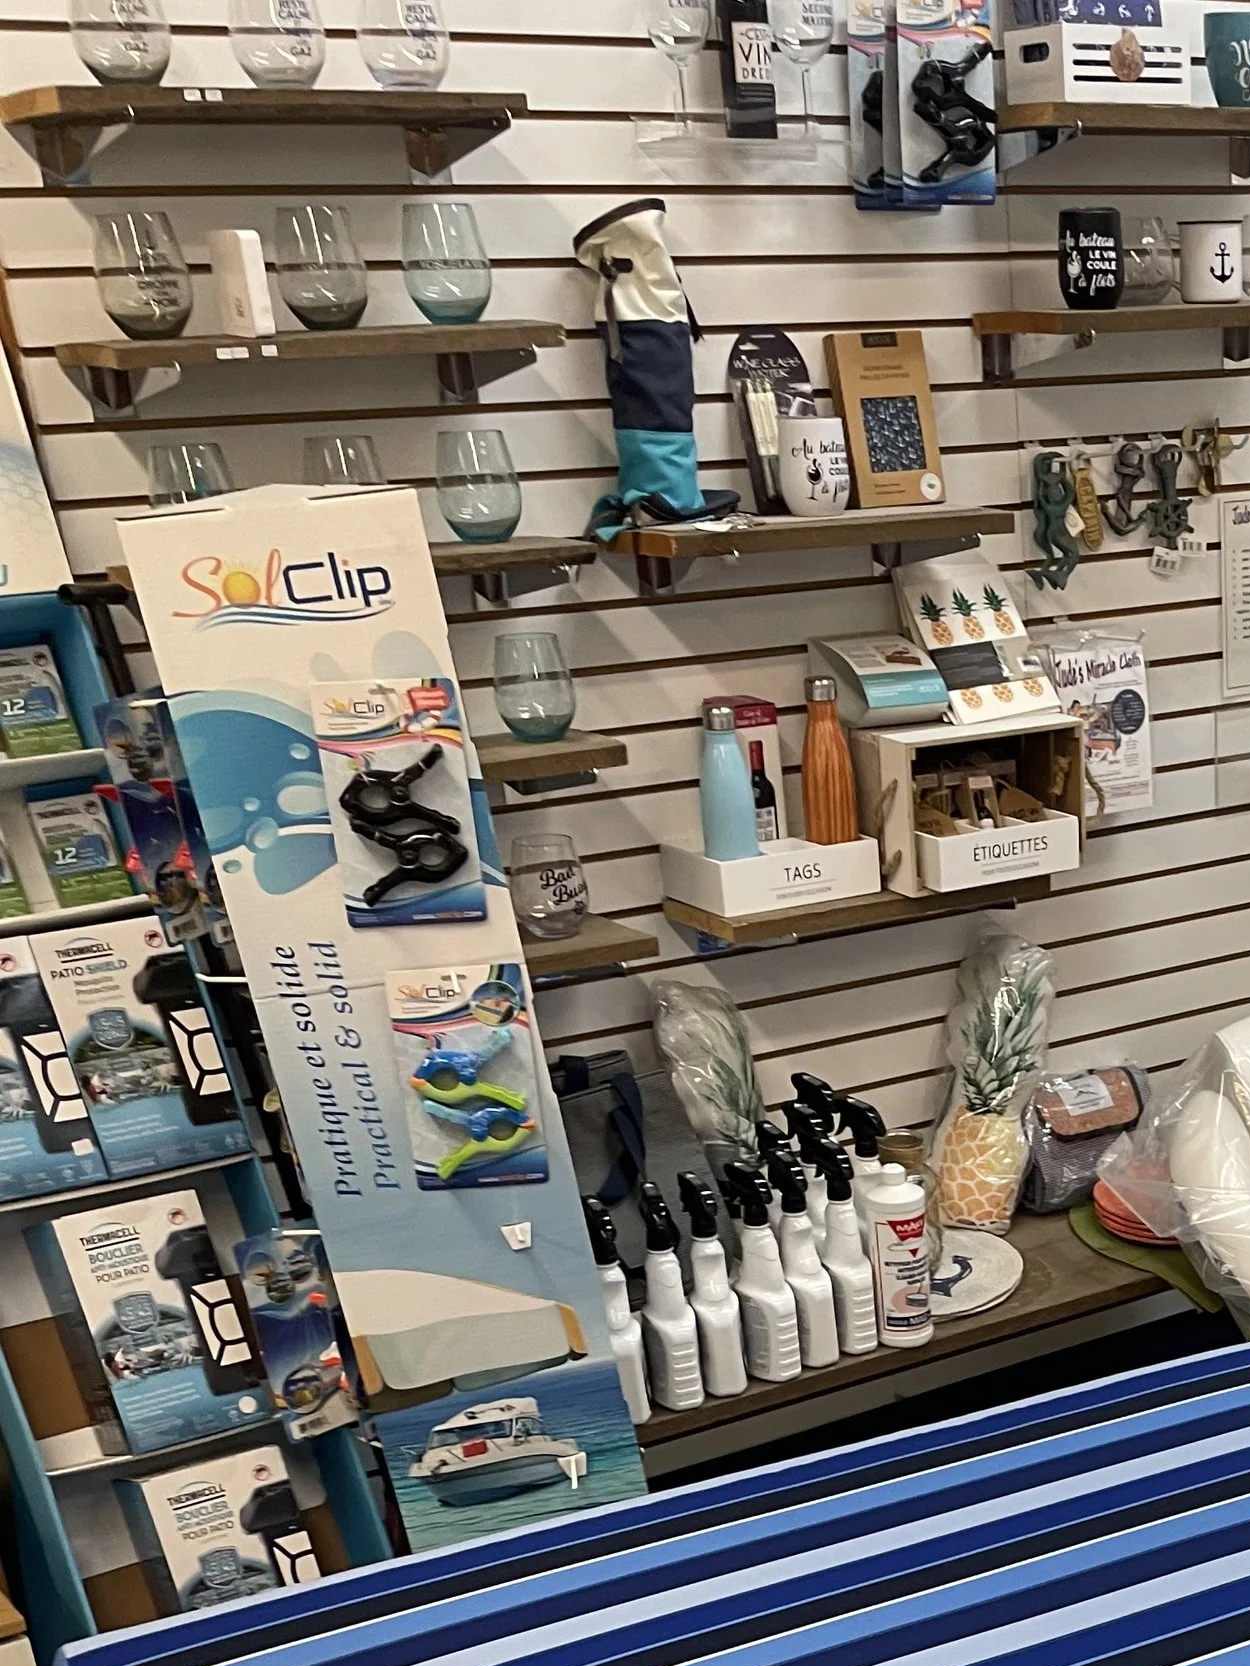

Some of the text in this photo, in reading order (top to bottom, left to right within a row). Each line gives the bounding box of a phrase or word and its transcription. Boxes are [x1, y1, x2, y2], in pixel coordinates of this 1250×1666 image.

[1086, 260, 1117, 270] COULE
[1054, 650, 1142, 689] Jude's Miracle Cloth
[2, 698, 26, 716] 12
[53, 847, 77, 865] 12
[973, 836, 1049, 862] ÉTIQUETTES
[783, 863, 822, 883] TAGS
[50, 965, 84, 980] PATIO
[270, 946, 363, 1199] Pratique et solide
[308, 941, 400, 1190] Practical & solid
[79, 1226, 142, 1247] THERMACELL
[88, 1243, 144, 1265] BOUCLIER
[96, 1264, 150, 1283] POUR PATIO
